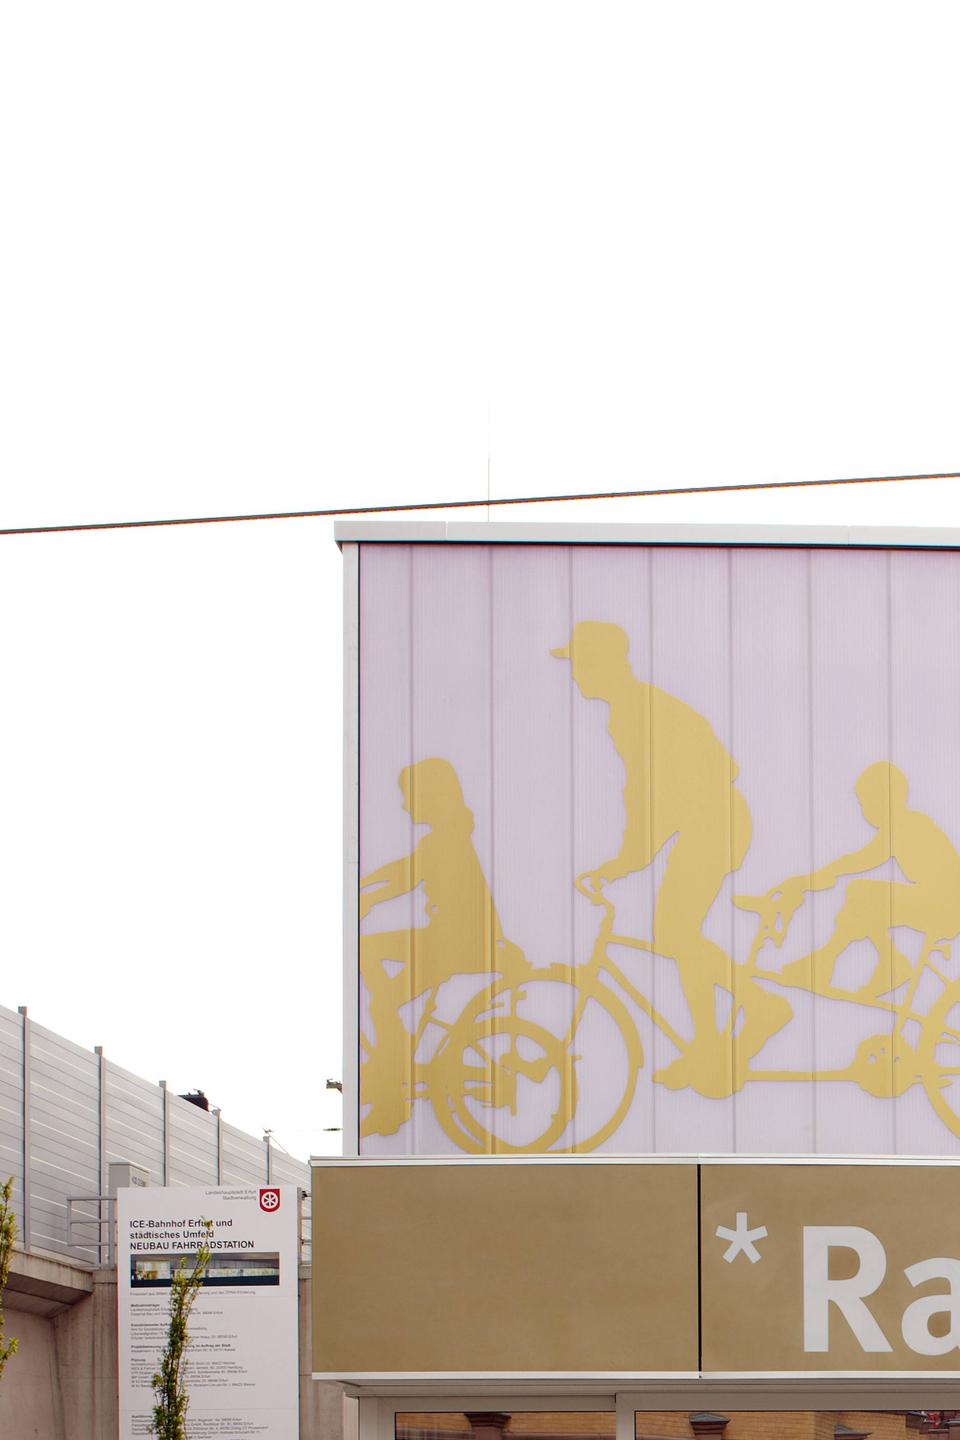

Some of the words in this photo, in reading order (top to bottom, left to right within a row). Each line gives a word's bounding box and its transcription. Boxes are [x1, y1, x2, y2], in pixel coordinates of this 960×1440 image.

[129, 1219, 186, 1228] ICE-Bahnhof
[216, 1219, 233, 1227] und
[129, 1231, 180, 1240] städtisches
[183, 1230, 215, 1239] Umfeld
[129, 1242, 170, 1250] NEUBAU
[172, 1240, 255, 1250] FAHRRADSTATION
